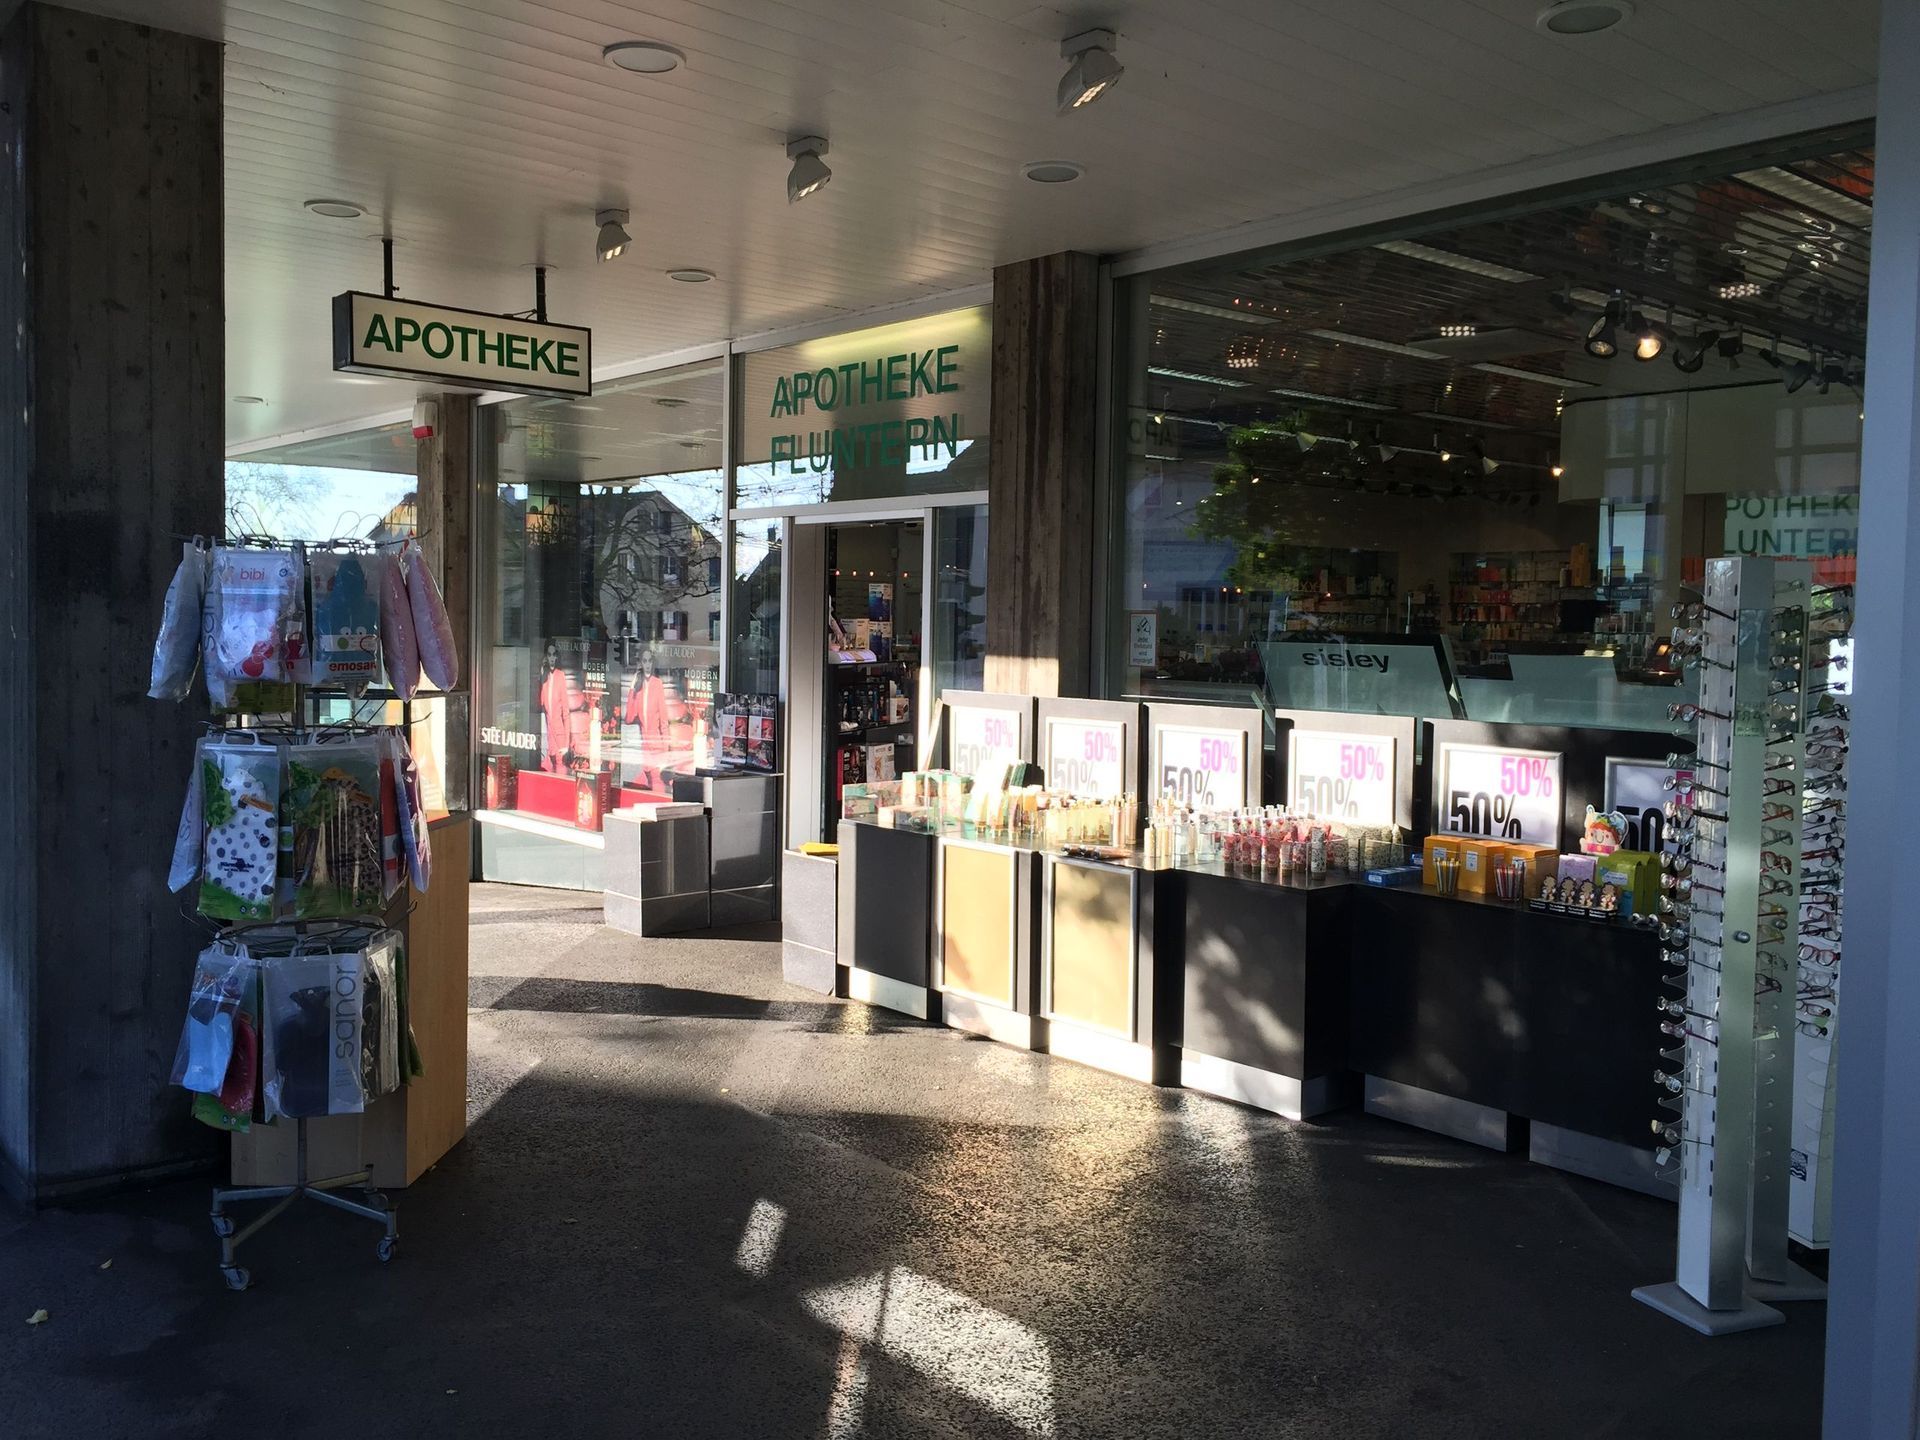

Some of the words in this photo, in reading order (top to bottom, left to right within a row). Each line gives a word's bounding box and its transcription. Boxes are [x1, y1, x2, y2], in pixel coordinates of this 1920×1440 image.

[363, 313, 580, 377] APOTHEKE
[770, 344, 959, 418] APOTHEKE
[771, 413, 958, 476] FLUNTERN
[240, 567, 265, 580] bibi
[582, 662, 610, 672] MODERN
[586, 672, 606, 682] MUSE
[684, 669, 718, 681] MODERN
[1303, 648, 1390, 673] sisley
[690, 681, 713, 691] MUSE
[502, 730, 537, 751] LAUDER
[984, 718, 1014, 748] 50%
[1084, 731, 1117, 763] 50%
[1200, 738, 1237, 773] 50%
[1340, 743, 1385, 781] 50%
[1053, 758, 1098, 793] 50%
[1163, 765, 1214, 807] 50%
[1500, 756, 1553, 797] 50%
[1299, 774, 1359, 818] 50%
[1450, 790, 1522, 840] 50%
[334, 965, 357, 1060] sanor
